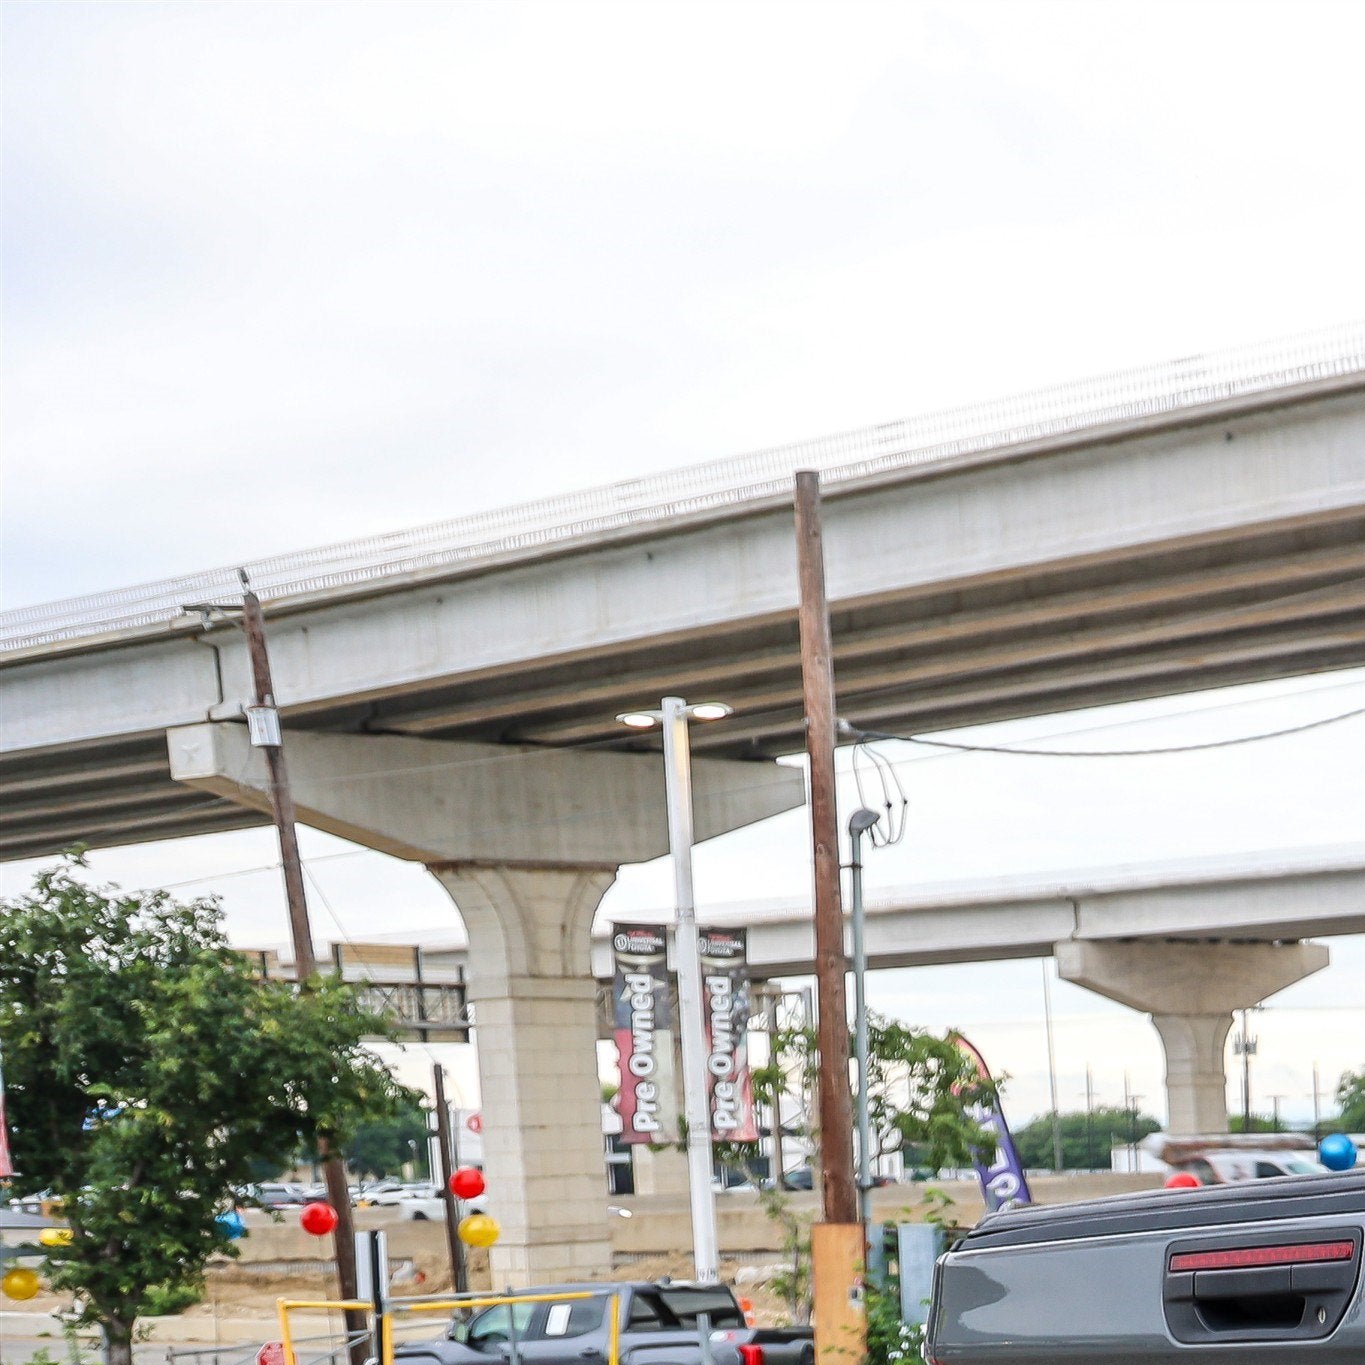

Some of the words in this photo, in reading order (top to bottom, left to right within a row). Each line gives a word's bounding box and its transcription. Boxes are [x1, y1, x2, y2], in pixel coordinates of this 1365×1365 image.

[625, 973, 656, 1077] Owned
[706, 976, 735, 1076] Owned
[632, 1081, 661, 1132] Pre
[713, 1081, 738, 1130] Pre
